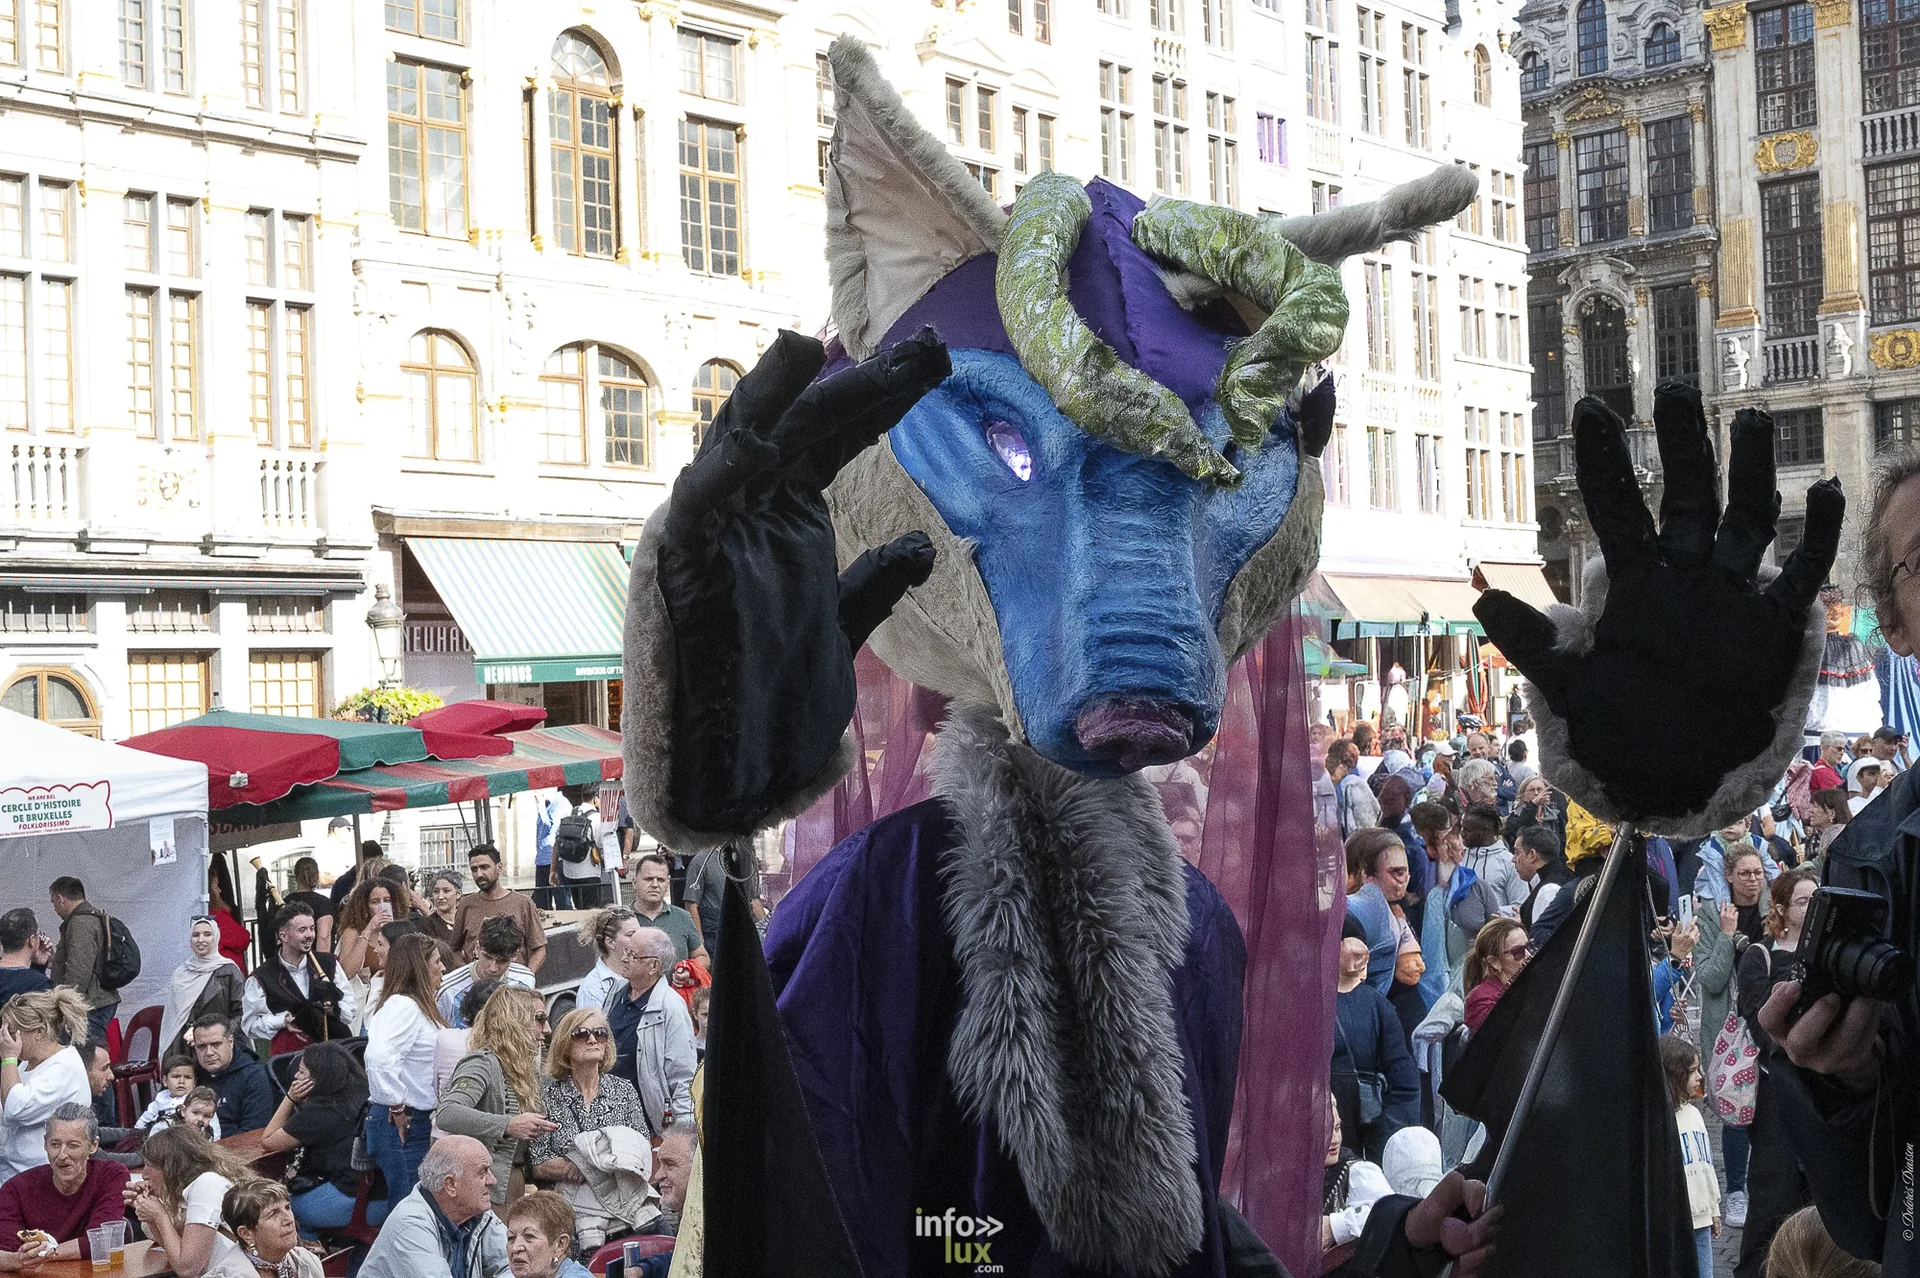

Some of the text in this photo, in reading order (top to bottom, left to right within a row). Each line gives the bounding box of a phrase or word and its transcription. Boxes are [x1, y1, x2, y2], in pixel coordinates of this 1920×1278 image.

[484, 665, 533, 683] NEUHAUS
[1, 799, 82, 813] CERCLE D'HISTOIRE
[13, 810, 73, 823] DE BRUXELLES
[18, 820, 70, 830] FOLKLORISSIMO
